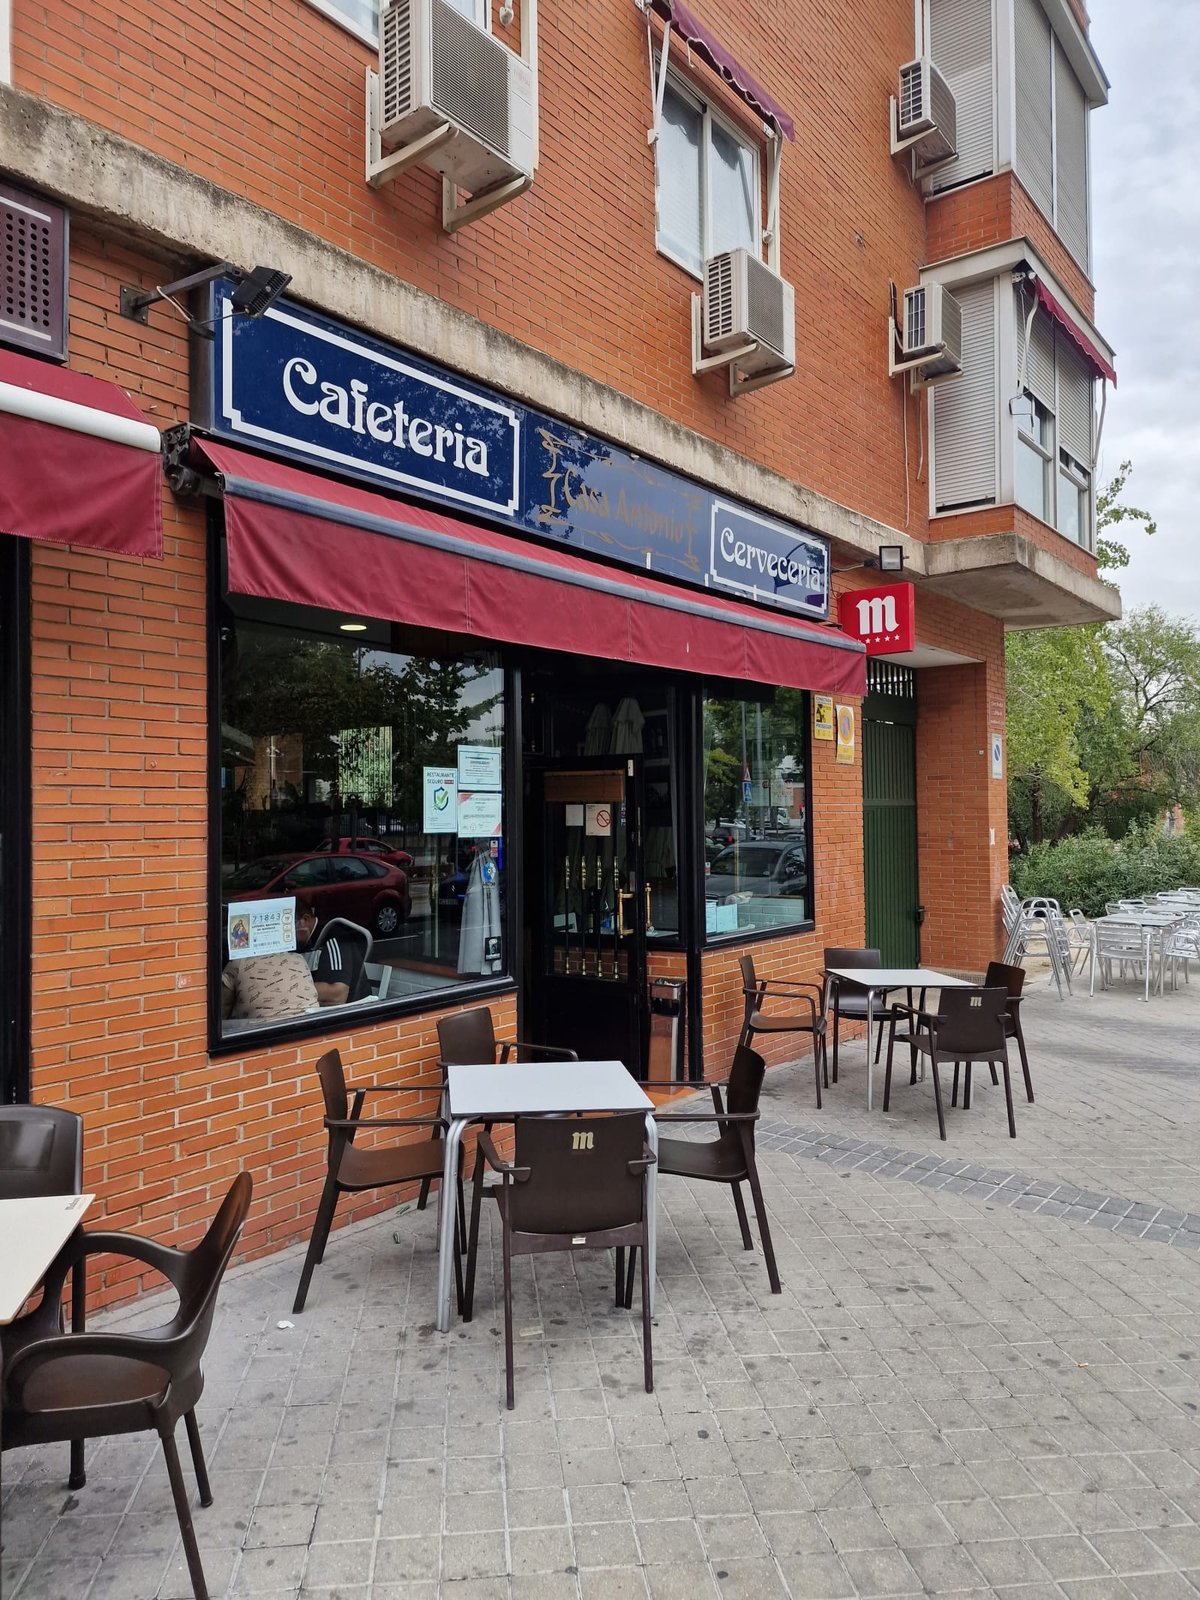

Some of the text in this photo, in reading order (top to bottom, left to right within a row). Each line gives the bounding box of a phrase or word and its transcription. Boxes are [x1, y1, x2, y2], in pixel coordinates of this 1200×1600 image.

[282, 357, 490, 477] Cafeteria
[563, 466, 684, 544] Casa Antonio
[719, 526, 822, 592] Cerveceria
[252, 912, 281, 922] 71843
